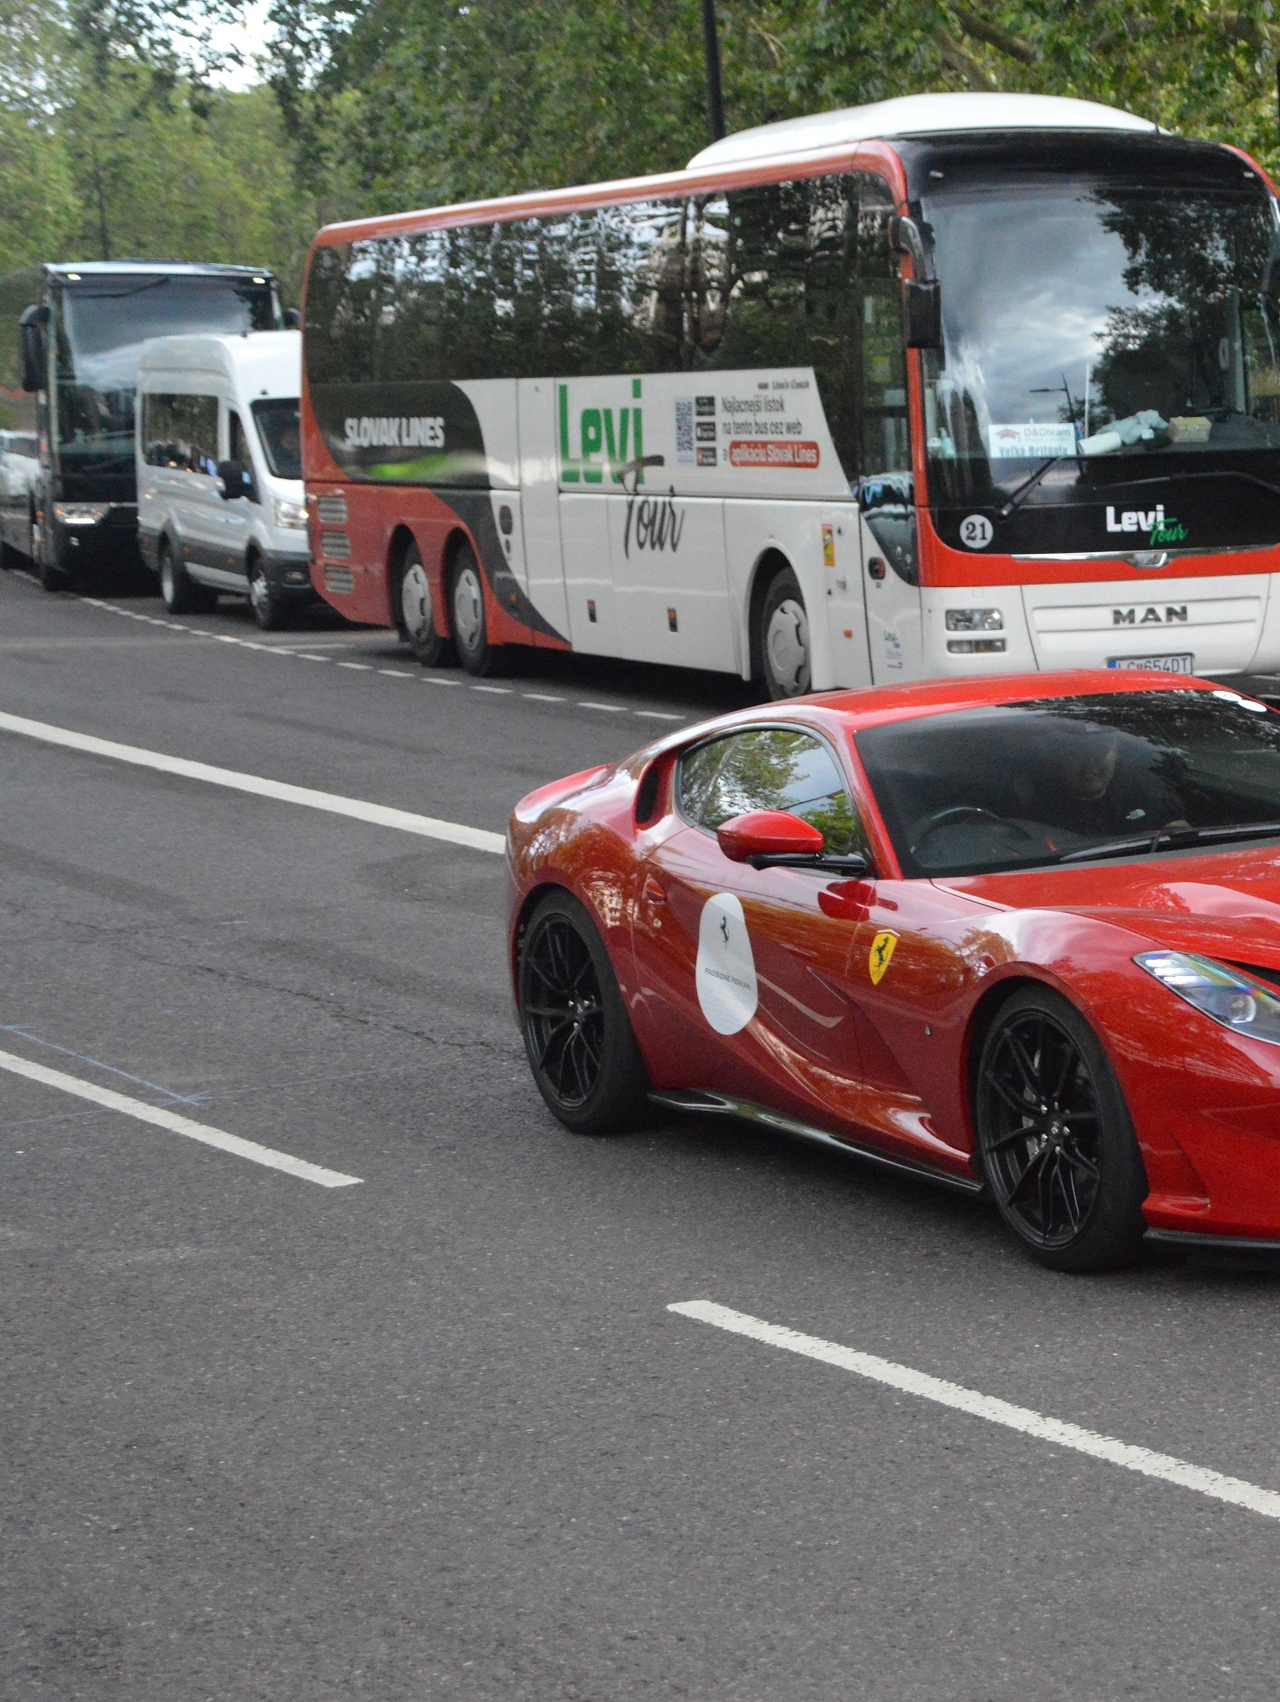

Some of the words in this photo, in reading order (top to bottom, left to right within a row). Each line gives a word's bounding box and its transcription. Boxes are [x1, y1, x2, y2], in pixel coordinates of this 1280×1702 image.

[344, 416, 400, 448] SLOVAK
[401, 416, 446, 448] LINES
[559, 378, 644, 485] Levi
[753, 419, 768, 435] bus
[769, 421, 783, 435] cez
[785, 418, 802, 435] web
[617, 455, 685, 559] Tour
[1106, 504, 1165, 533] Levi
[965, 521, 988, 543] 21
[1148, 517, 1189, 546] Tour
[1113, 605, 1188, 625] MAN
